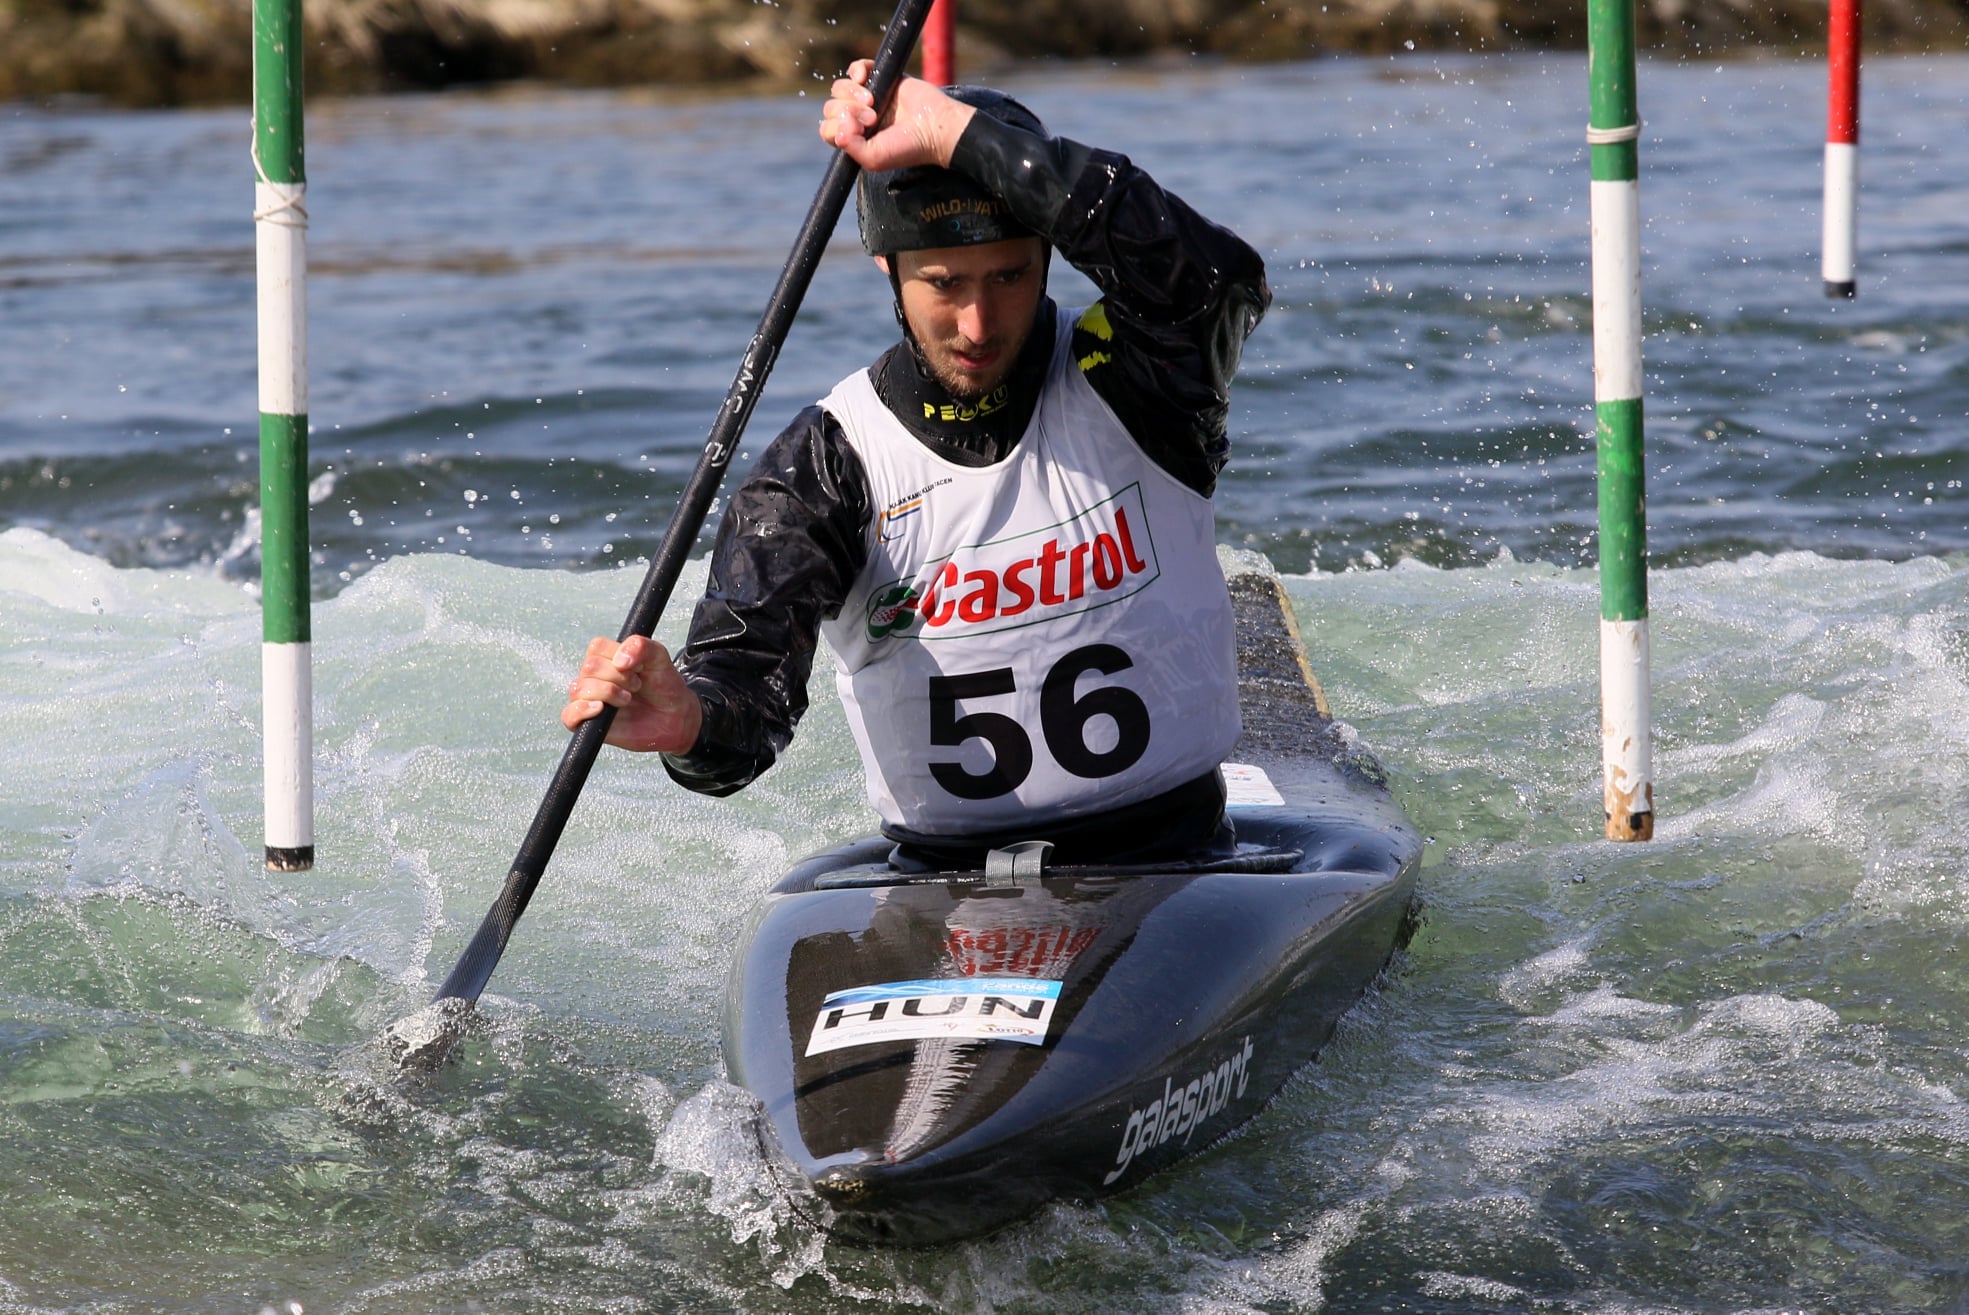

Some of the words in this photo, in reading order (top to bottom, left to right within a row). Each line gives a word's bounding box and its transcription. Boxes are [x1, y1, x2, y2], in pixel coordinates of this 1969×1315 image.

[922, 505, 1146, 627] Castrol
[928, 643, 1150, 800] 56
[824, 996, 1045, 1030] HUN
[1103, 1035, 1254, 1186] galasport
